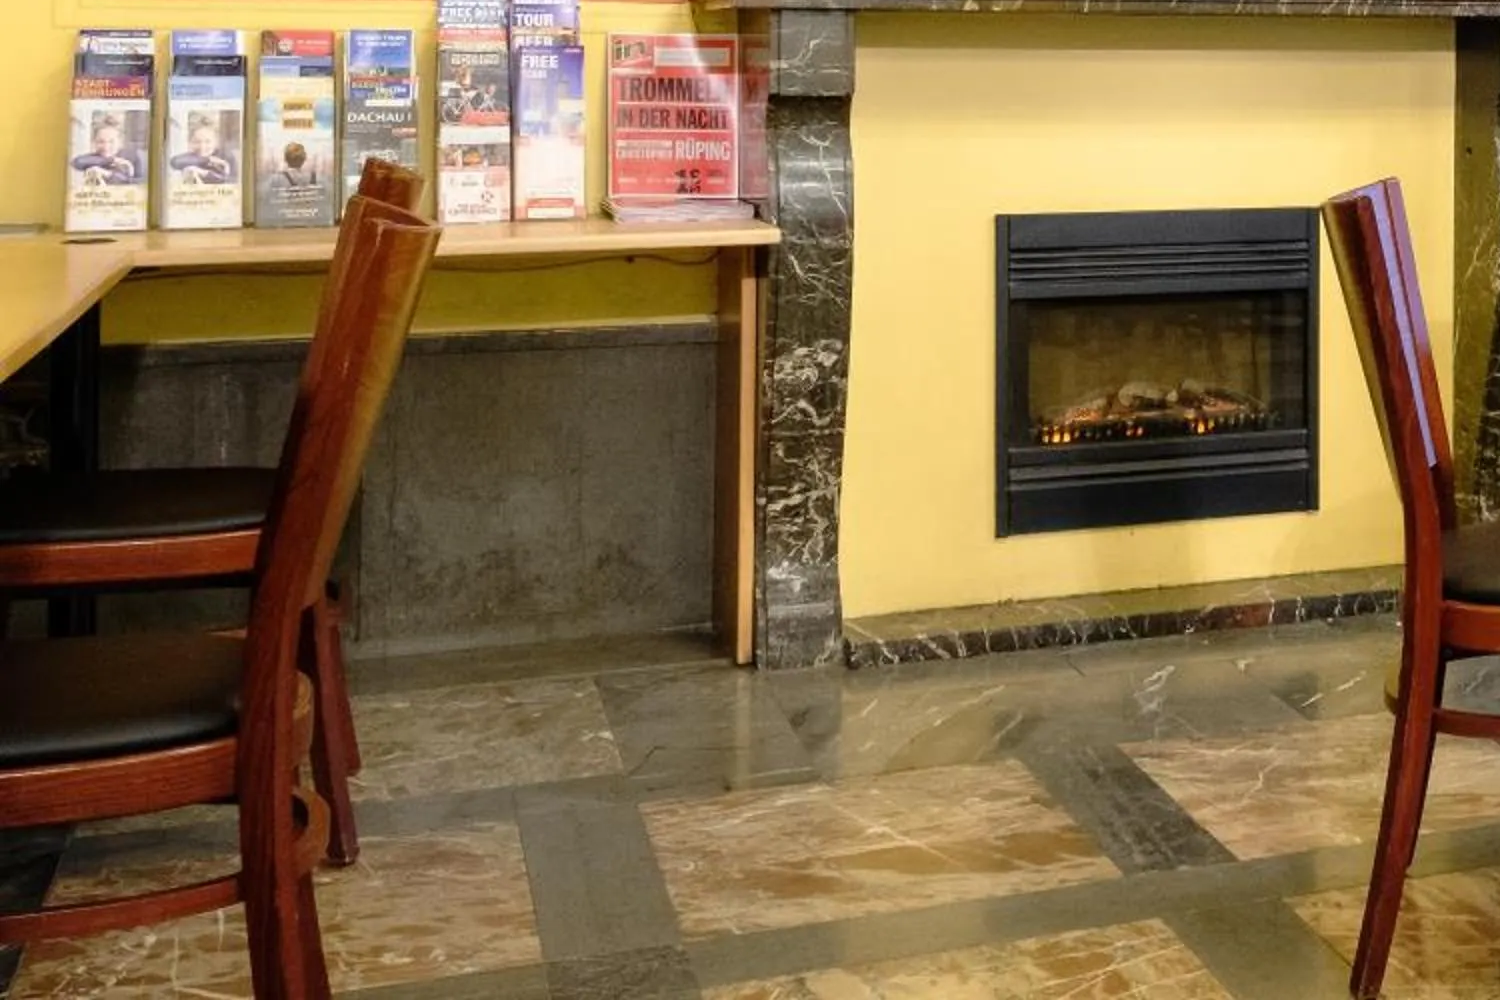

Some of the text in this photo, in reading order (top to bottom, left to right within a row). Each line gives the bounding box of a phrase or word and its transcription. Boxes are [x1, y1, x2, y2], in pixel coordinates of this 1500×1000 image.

[617, 77, 730, 101] TROMMEL
[347, 111, 405, 123] DACHAU
[639, 107, 671, 128] DER
[675, 107, 729, 129] NACHT
[674, 137, 732, 161] RÜPING
